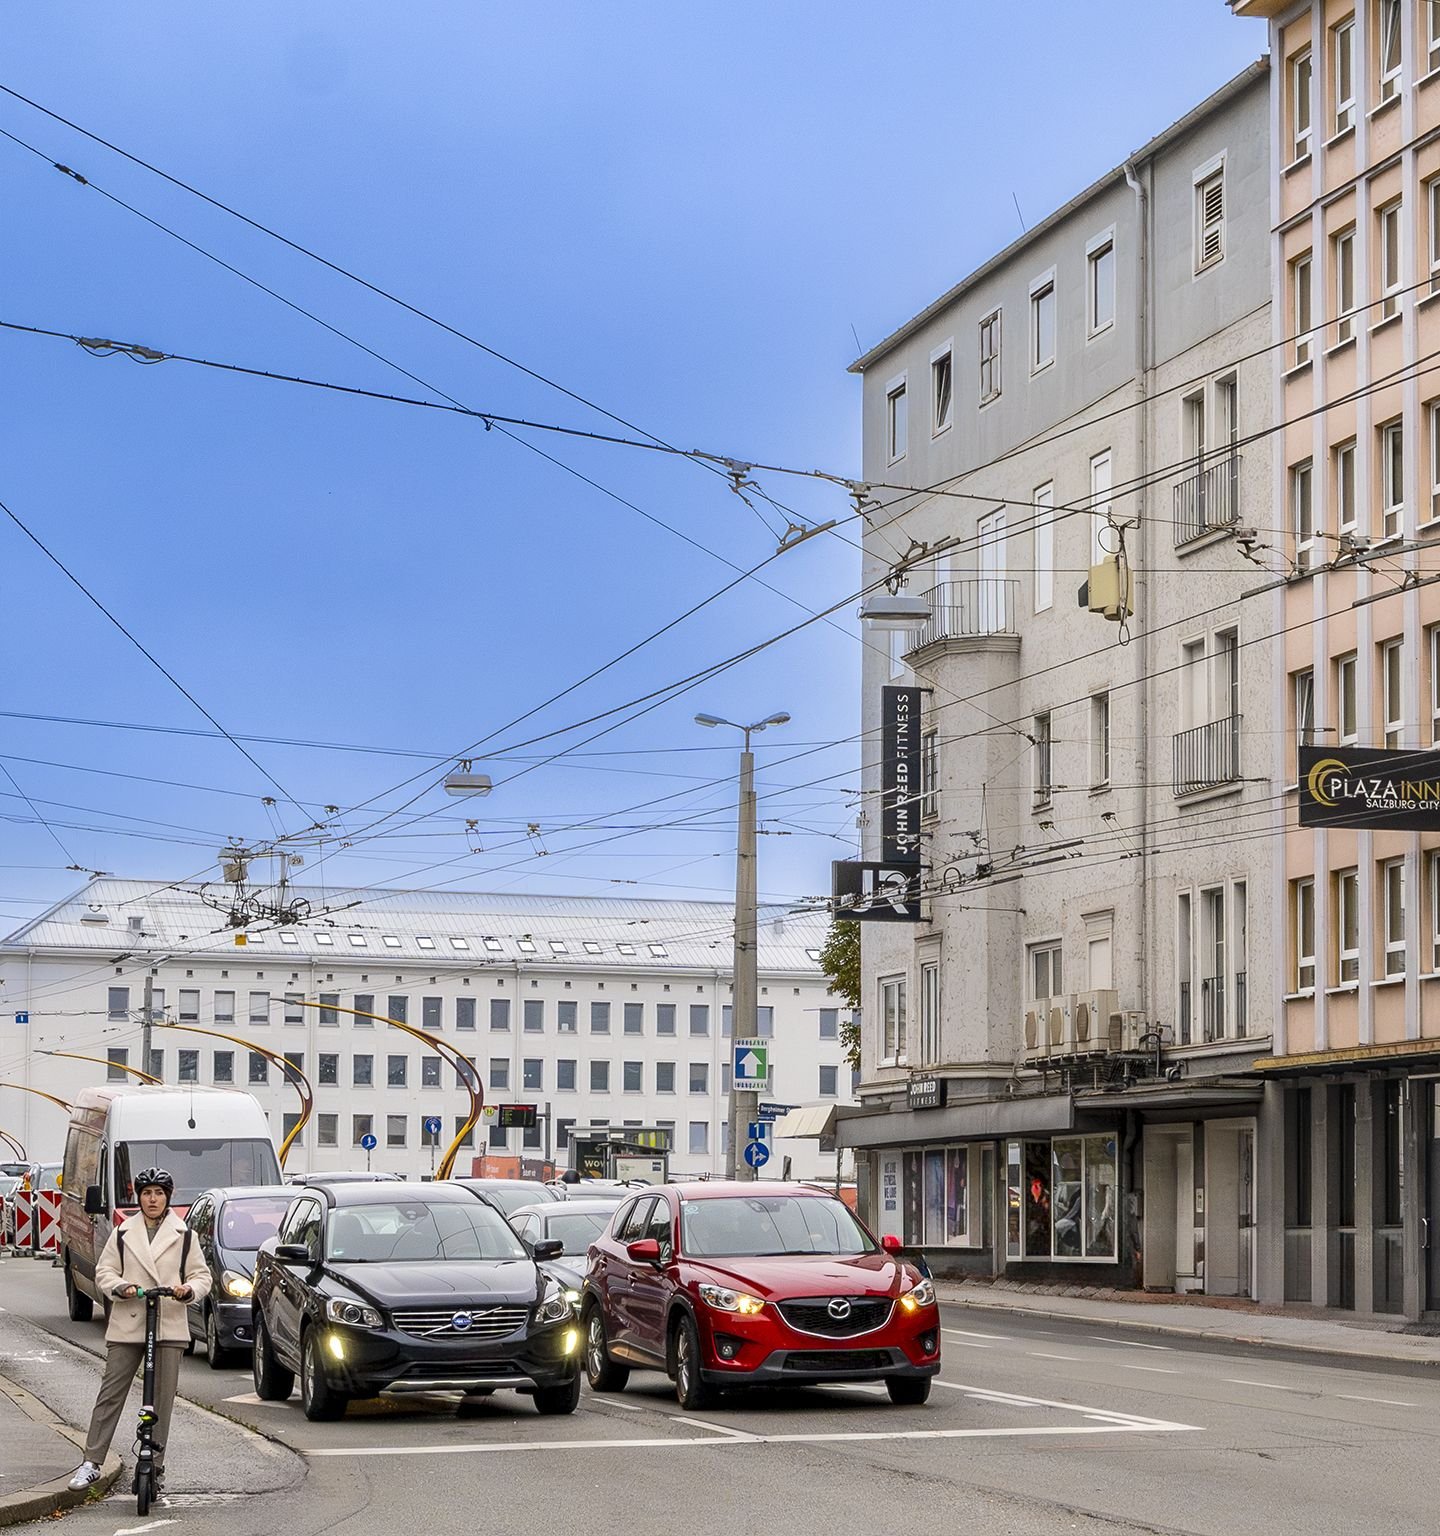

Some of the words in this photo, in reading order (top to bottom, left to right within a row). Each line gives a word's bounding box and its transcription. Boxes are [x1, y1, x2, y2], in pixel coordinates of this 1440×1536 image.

[897, 694, 909, 758] FITNESS
[896, 764, 908, 806] REED
[1331, 778, 1398, 799] PLAZA
[1401, 780, 1440, 800] INN
[1366, 798, 1416, 810] SALZBURG
[1418, 800, 1440, 811] CITY
[896, 810, 908, 854] JOHN
